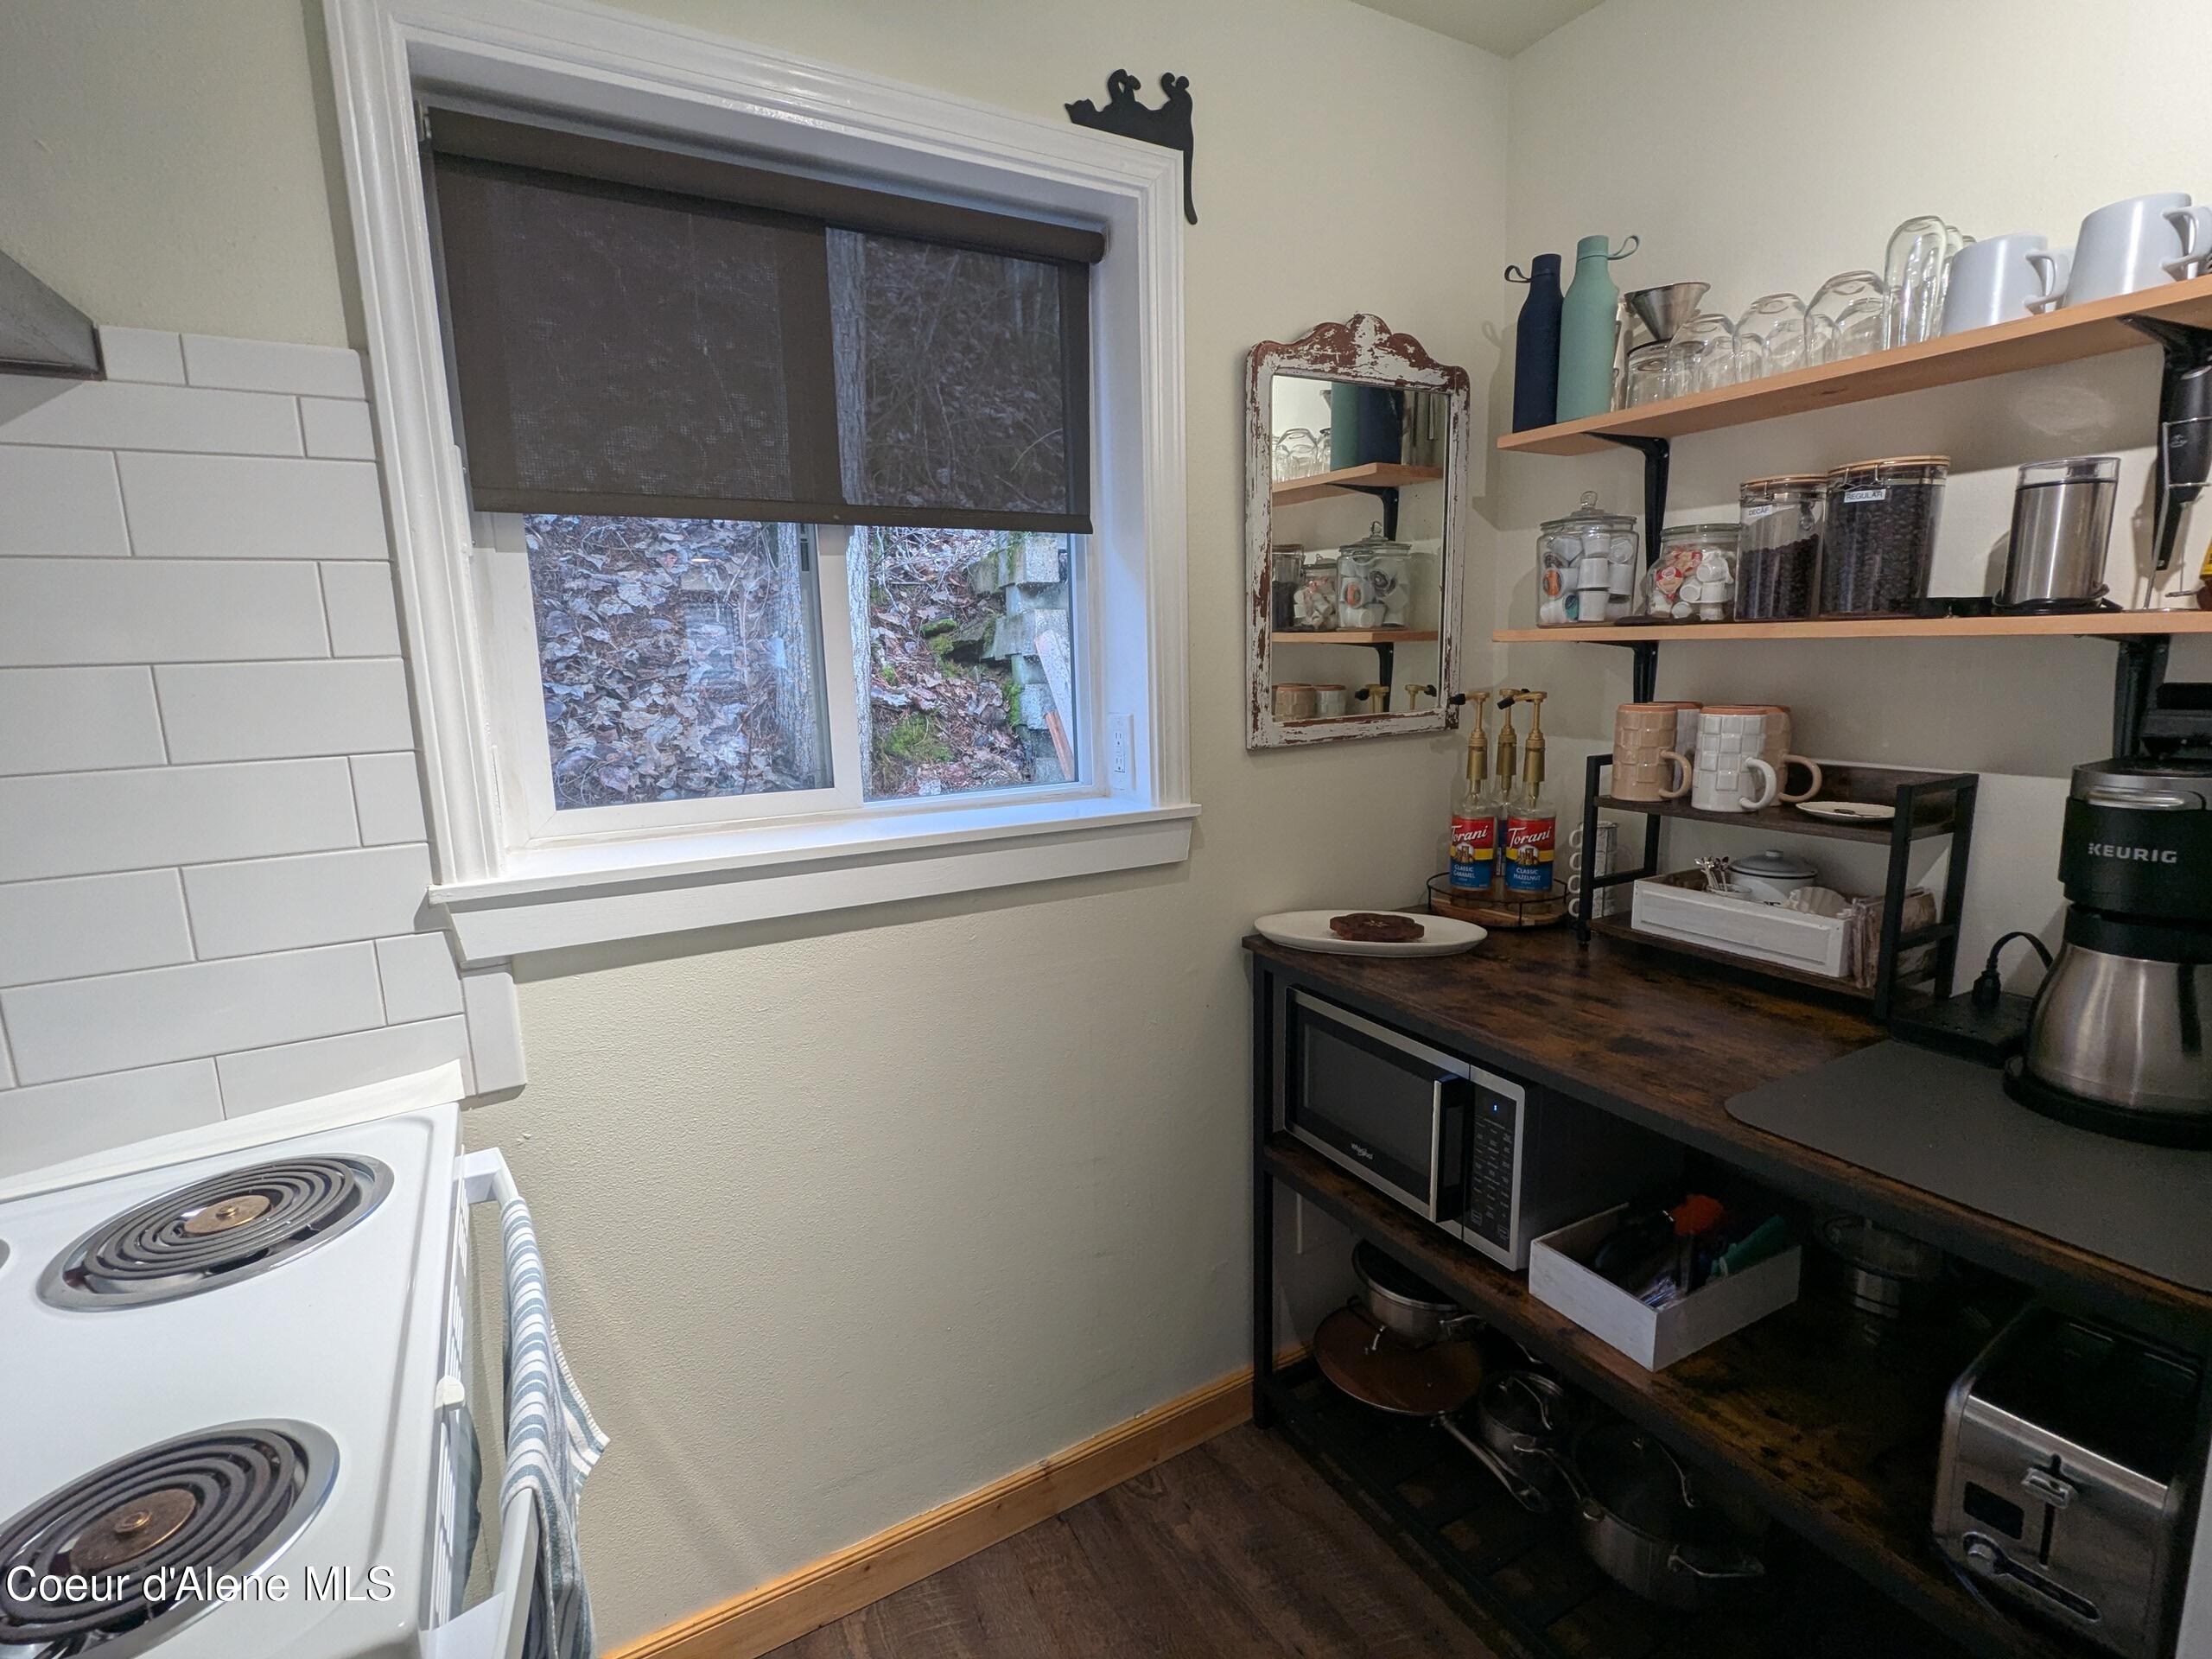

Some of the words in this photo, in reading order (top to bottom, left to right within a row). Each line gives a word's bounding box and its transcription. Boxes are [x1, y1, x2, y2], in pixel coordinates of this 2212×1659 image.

[1846, 491, 1884, 501] REGULAR
[1748, 506, 1770, 517] DECAF
[1508, 825, 1552, 849] Torani
[2088, 842, 2178, 864] KEURIG
[1454, 864, 1475, 873] CLASSIC
[1516, 867, 1539, 875] CLASSIC
[1513, 873, 1541, 881] HAZELNUT
